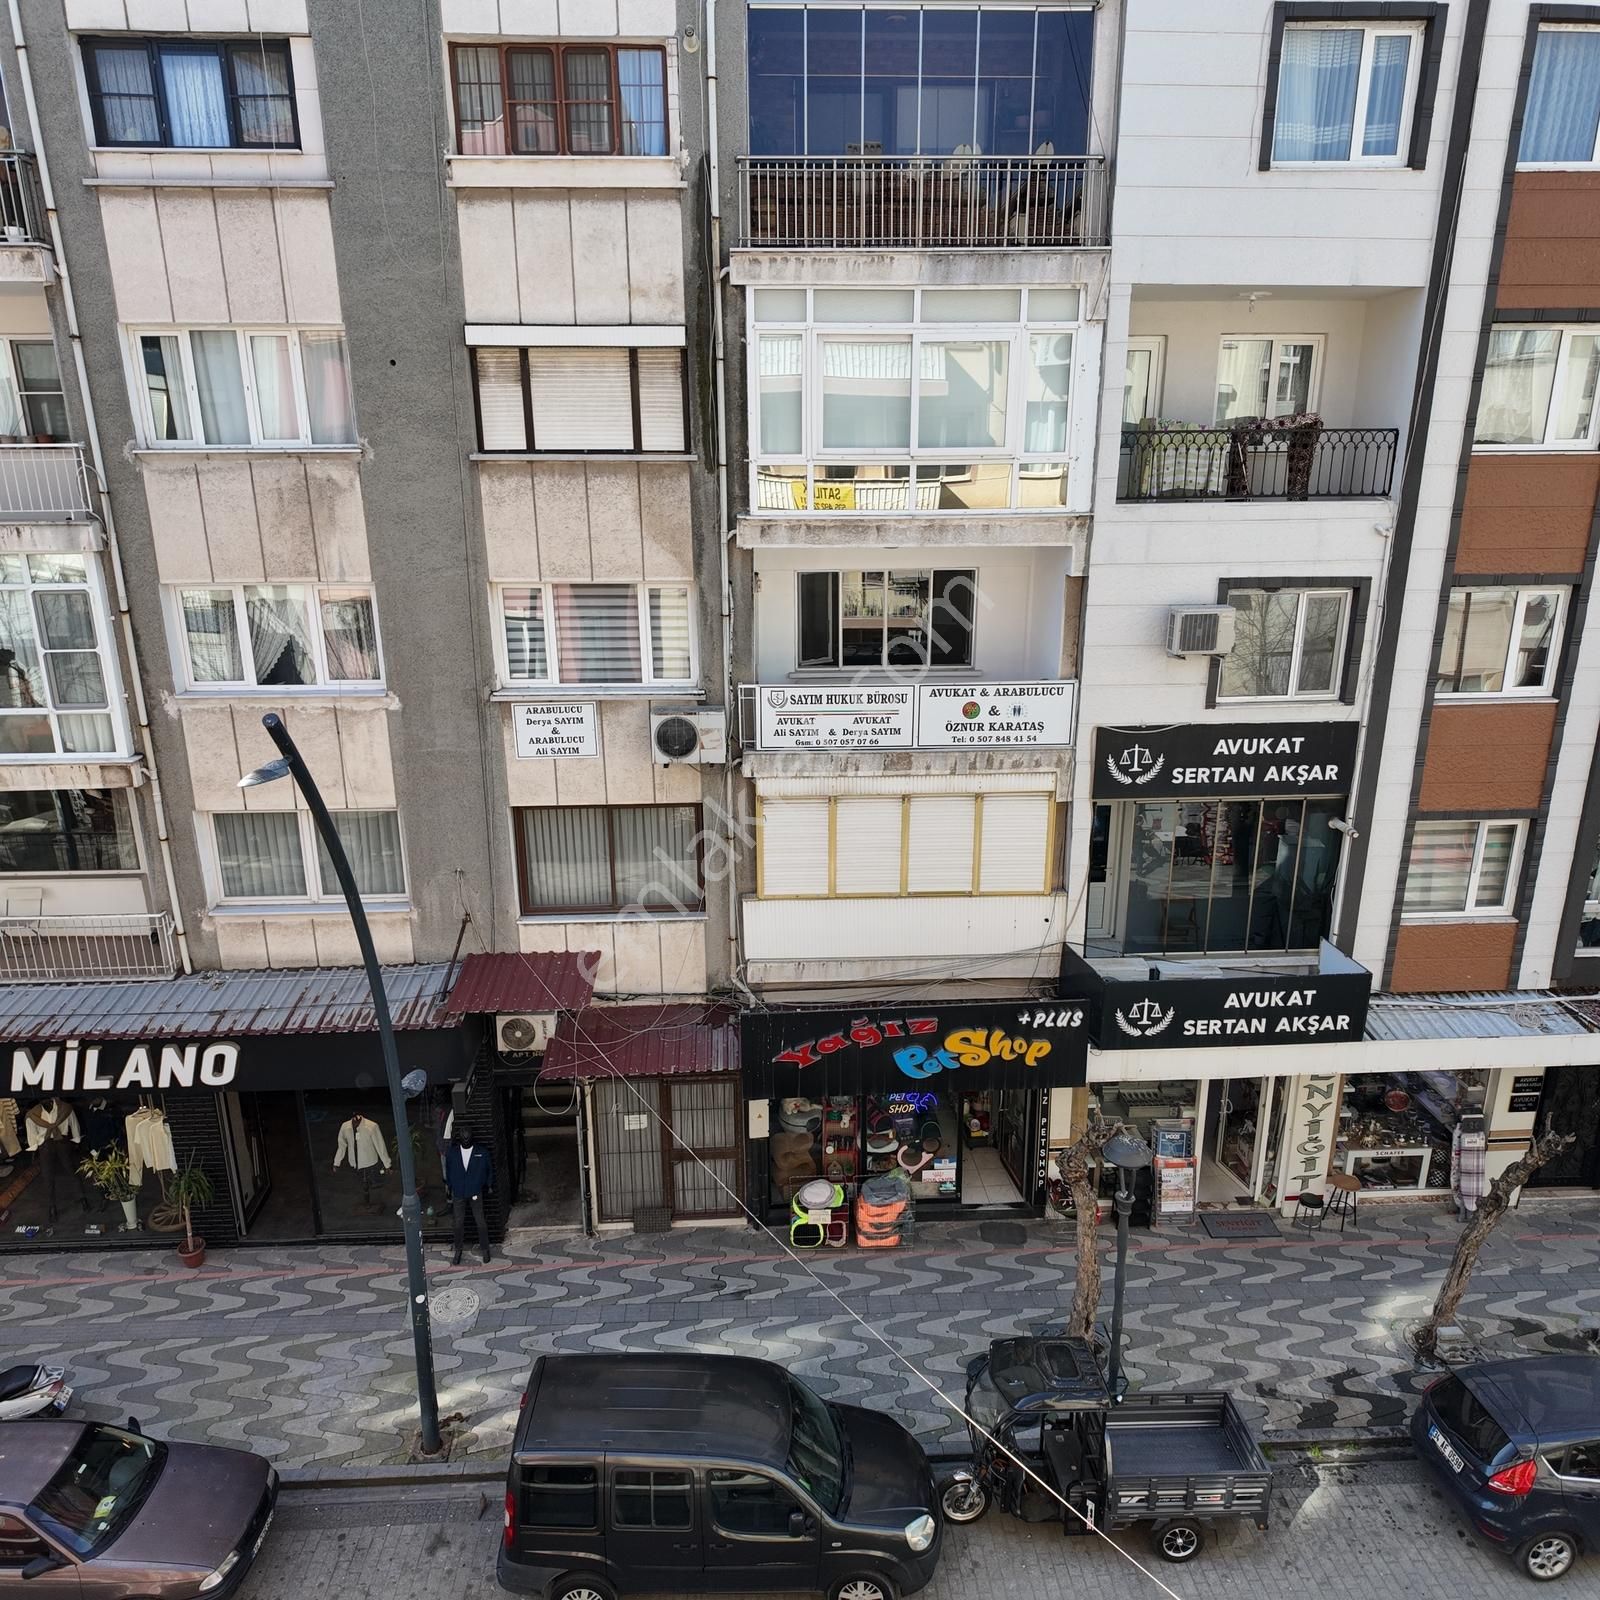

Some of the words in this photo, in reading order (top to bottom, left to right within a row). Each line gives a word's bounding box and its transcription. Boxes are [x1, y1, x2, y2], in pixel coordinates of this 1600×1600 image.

[790, 694, 823, 704] SAYIM
[826, 694, 864, 704] HUKUK
[866, 690, 908, 704] BÜROSU
[929, 688, 976, 698] AVUKAT
[980, 688, 990, 697] &
[994, 687, 1064, 696] ARABULUCU
[526, 706, 583, 714] ARABULUCU
[988, 706, 1000, 716] &
[526, 718, 552, 726] Derya
[554, 717, 584, 725] SAYIM
[776, 718, 816, 726] AVUKAT
[852, 716, 892, 724] AVUKAT
[552, 726, 560, 735] &
[945, 720, 984, 732] ÖZNUR
[988, 722, 1044, 733] KARATAŞ
[774, 728, 786, 736] Ali
[788, 728, 819, 736] SAYIM
[828, 728, 837, 736] &
[842, 728, 868, 738] Derya
[528, 736, 585, 744] ARABULUCU
[536, 747, 548, 755] Ali
[550, 746, 580, 755] SAYIM
[1212, 737, 1305, 756] AVUKAT
[1172, 766, 1254, 784] SERTAN
[1264, 764, 1339, 785] AKŞAR
[1224, 990, 1316, 1009] AVUKAT
[1183, 1018, 1266, 1036] SERTAN
[1275, 1015, 1350, 1035] AKŞAR
[10, 1040, 240, 1092] MİLANO
[889, 1104, 915, 1113] SHOP
[1290, 1074, 1336, 1192] NYİĞİT
[1038, 1118, 1047, 1187] PETSHOP
